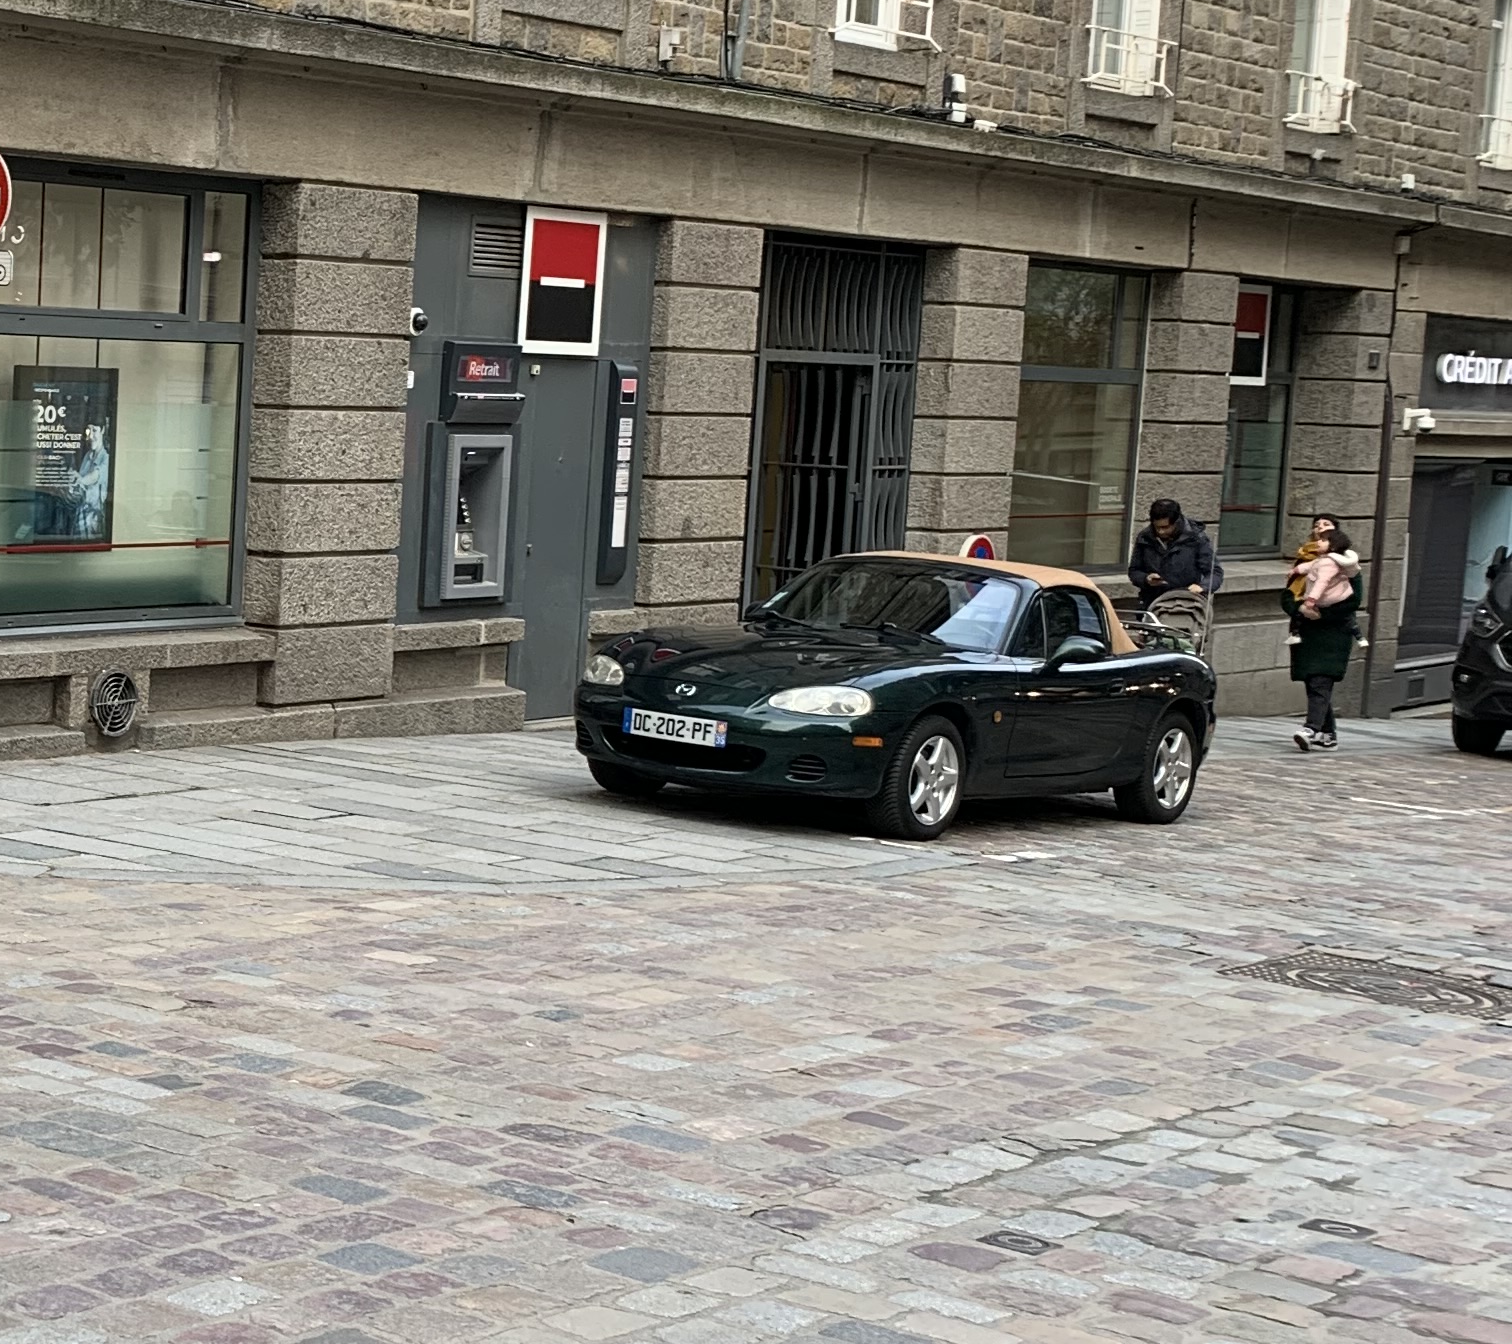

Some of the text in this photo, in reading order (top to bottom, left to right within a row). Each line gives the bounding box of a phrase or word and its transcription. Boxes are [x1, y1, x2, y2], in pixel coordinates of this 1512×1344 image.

[469, 361, 500, 376] Retrait
[1436, 350, 1502, 384] CRÉDIT
[633, 713, 713, 741] DC-202-PF
